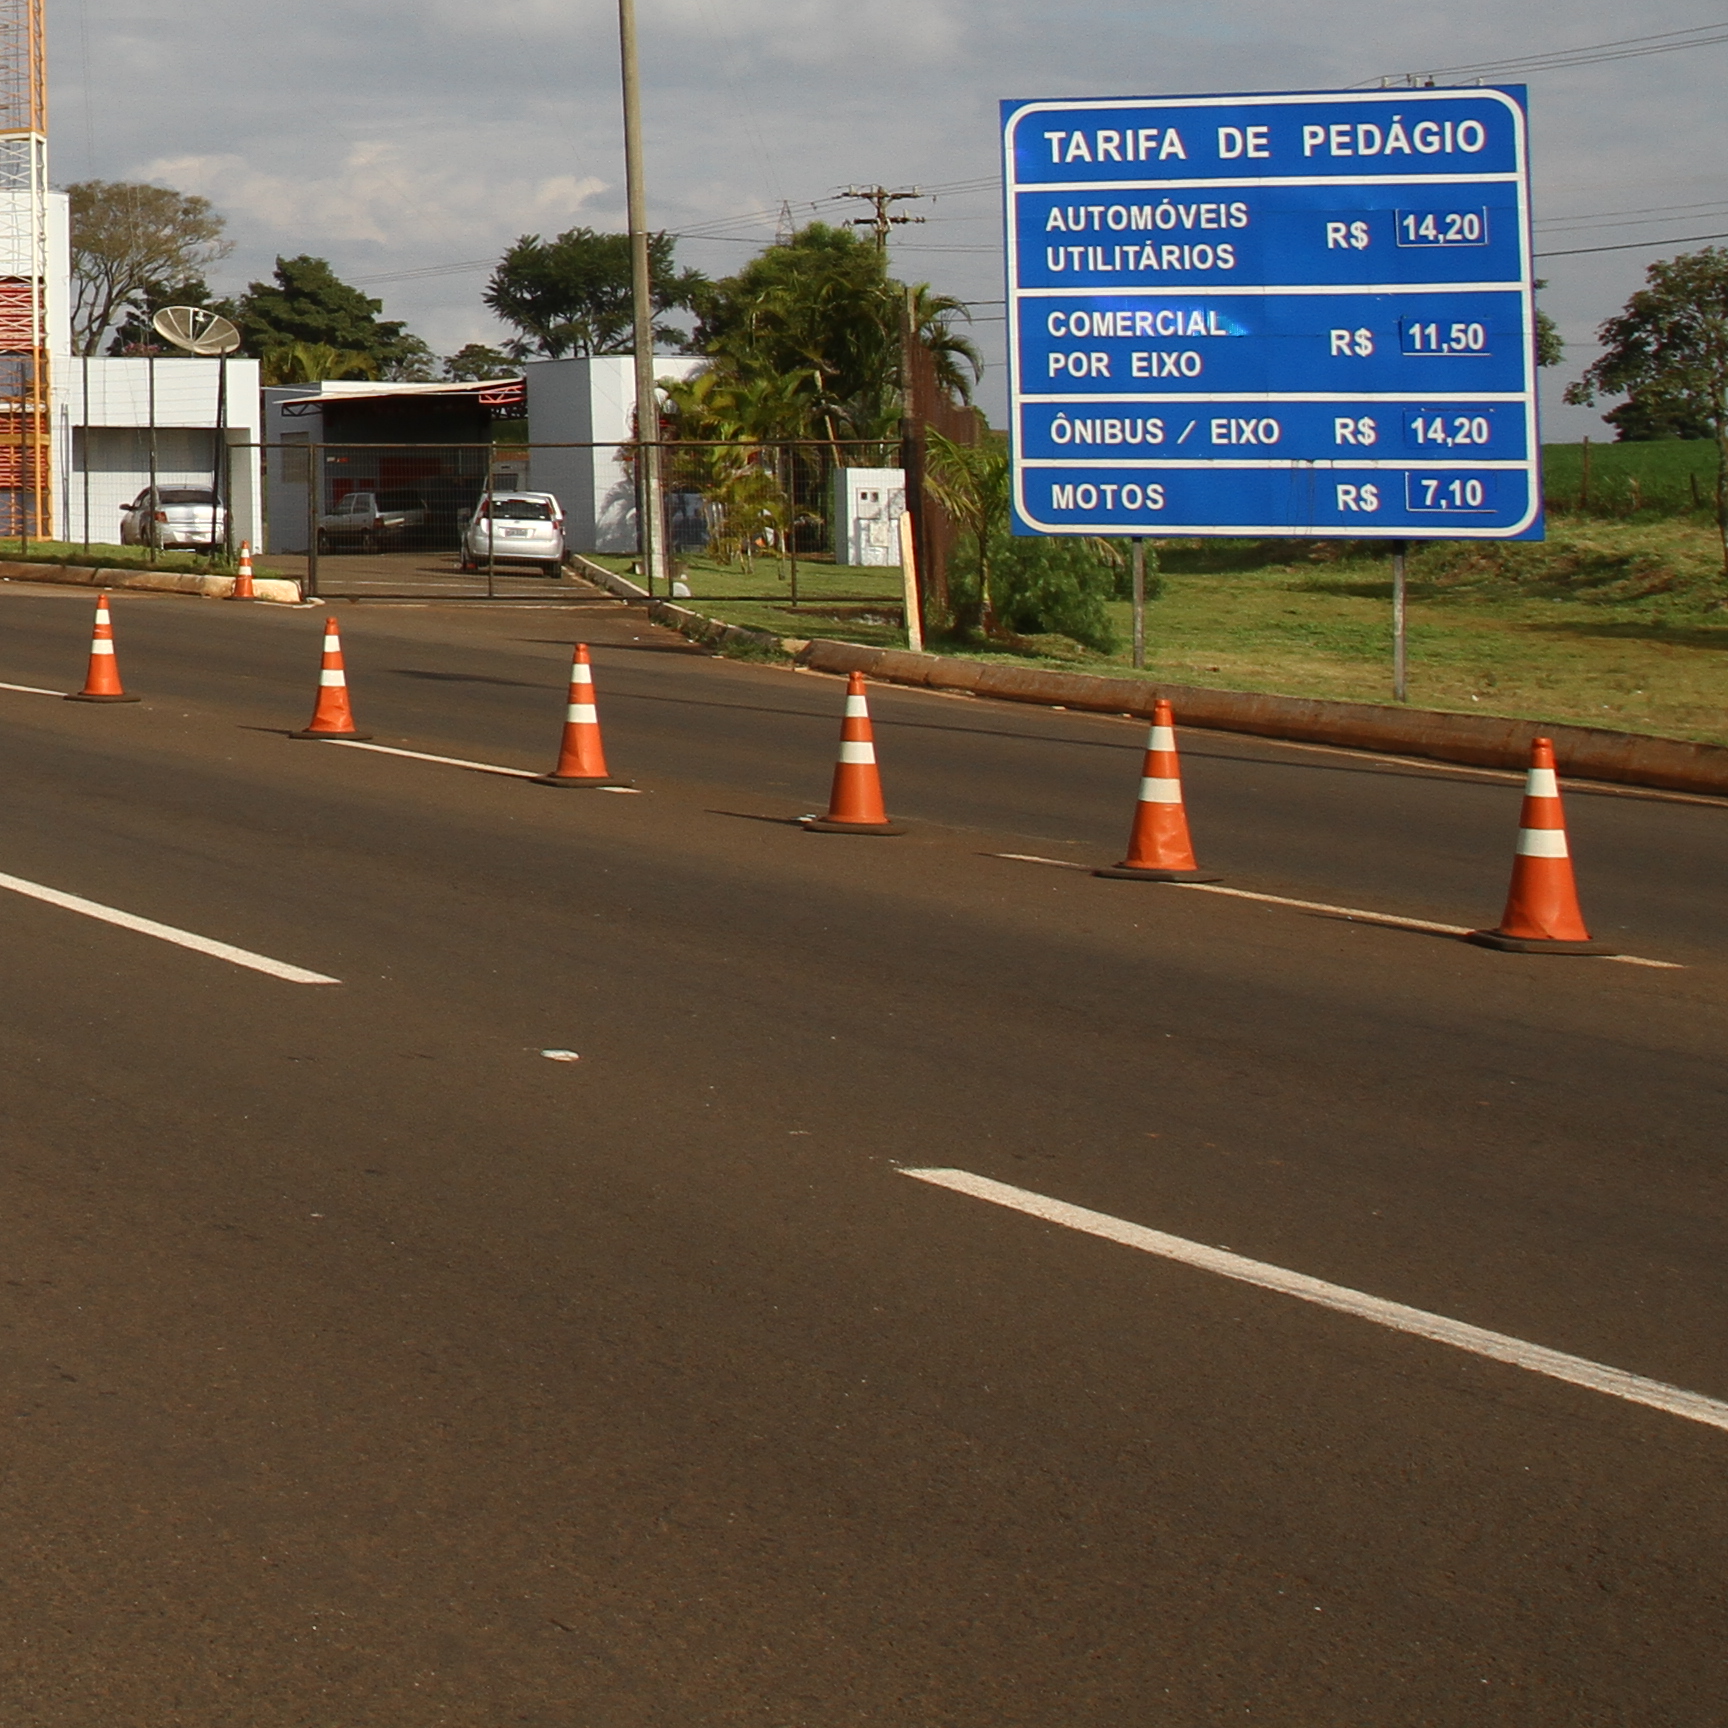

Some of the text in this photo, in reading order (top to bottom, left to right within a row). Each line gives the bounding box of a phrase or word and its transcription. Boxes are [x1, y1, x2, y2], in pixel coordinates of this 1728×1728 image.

[1043, 115, 1486, 163] TARIFA DE PEDÁGIO
[1045, 198, 1248, 231] AUTOMÓVEIS
[1326, 213, 1480, 250] R$ 14,20
[1046, 240, 1236, 271] UTILITÁRIOS
[1047, 310, 1227, 337] COMERCIAL
[1330, 323, 1485, 357] R$ 11,50
[1048, 351, 1202, 378] POR EIXO
[1050, 411, 1489, 447] ÔNIBUS / EIXO R$ 14,20
[1051, 479, 1483, 512] MOTOS R$ 7,10
